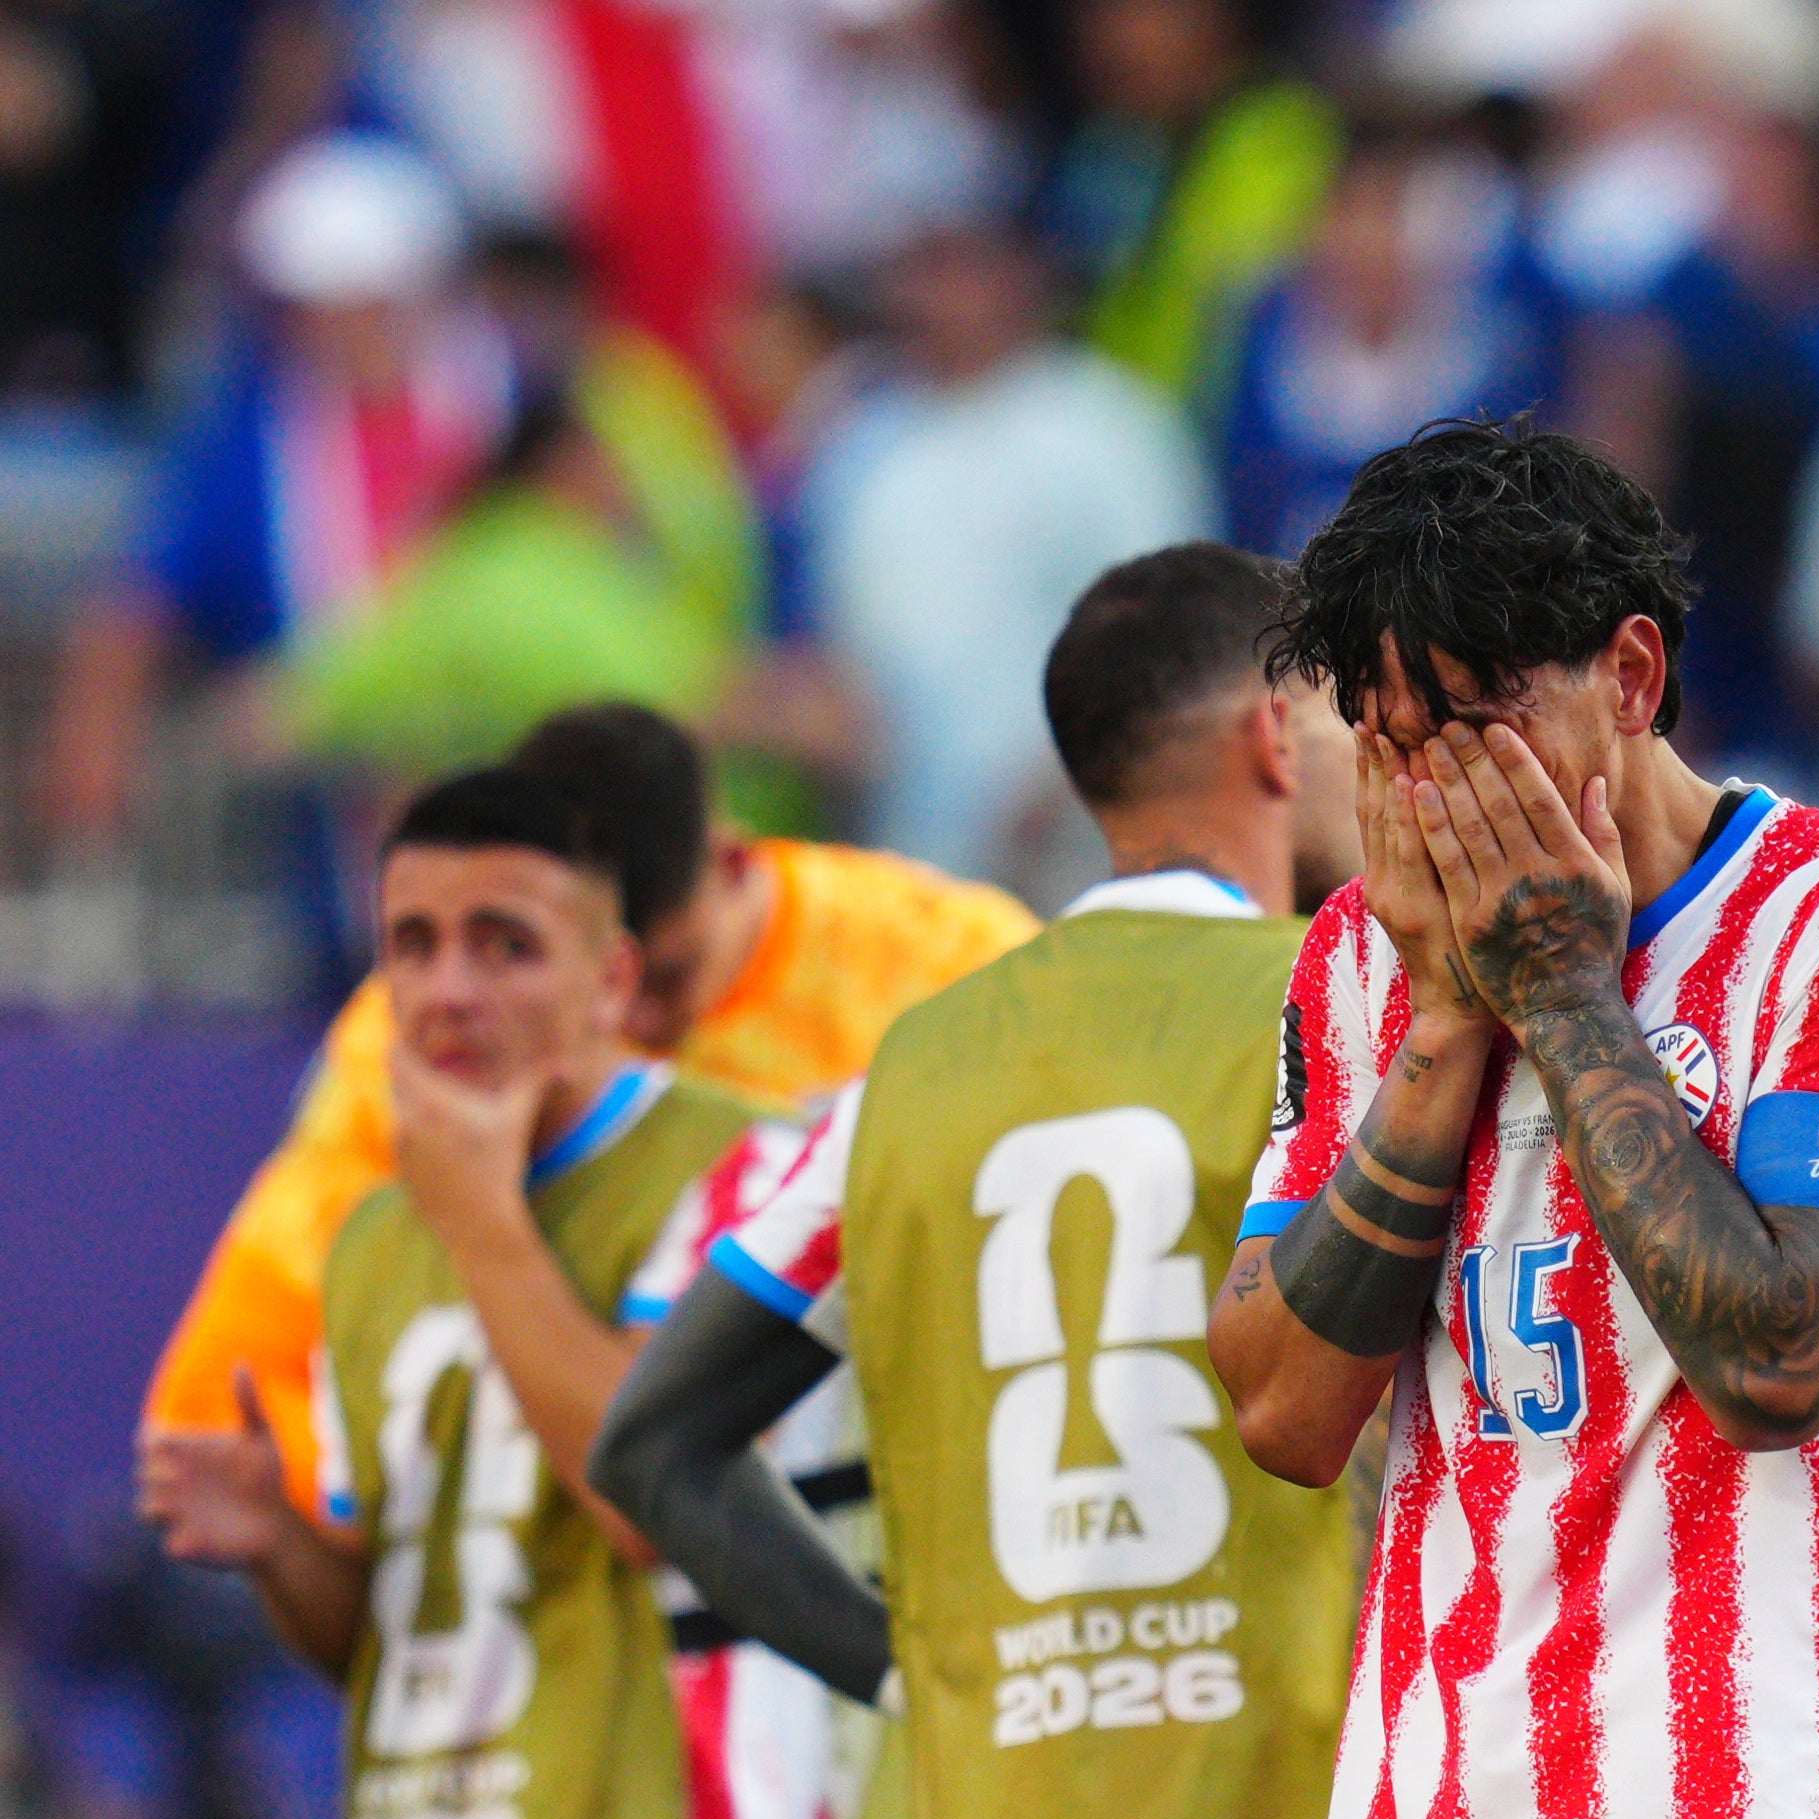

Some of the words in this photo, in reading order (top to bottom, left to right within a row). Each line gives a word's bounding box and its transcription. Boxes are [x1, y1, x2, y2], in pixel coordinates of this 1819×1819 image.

[1655, 1031, 1686, 1055] APF
[1508, 1128, 1528, 1140] JULIO
[1534, 1126, 1556, 1137] 2026
[1522, 1116, 1531, 1126] VS
[1459, 1232, 1590, 1443] 15
[1128, 1596, 1241, 1651] CUP
[993, 1649, 1245, 1748] 2026
